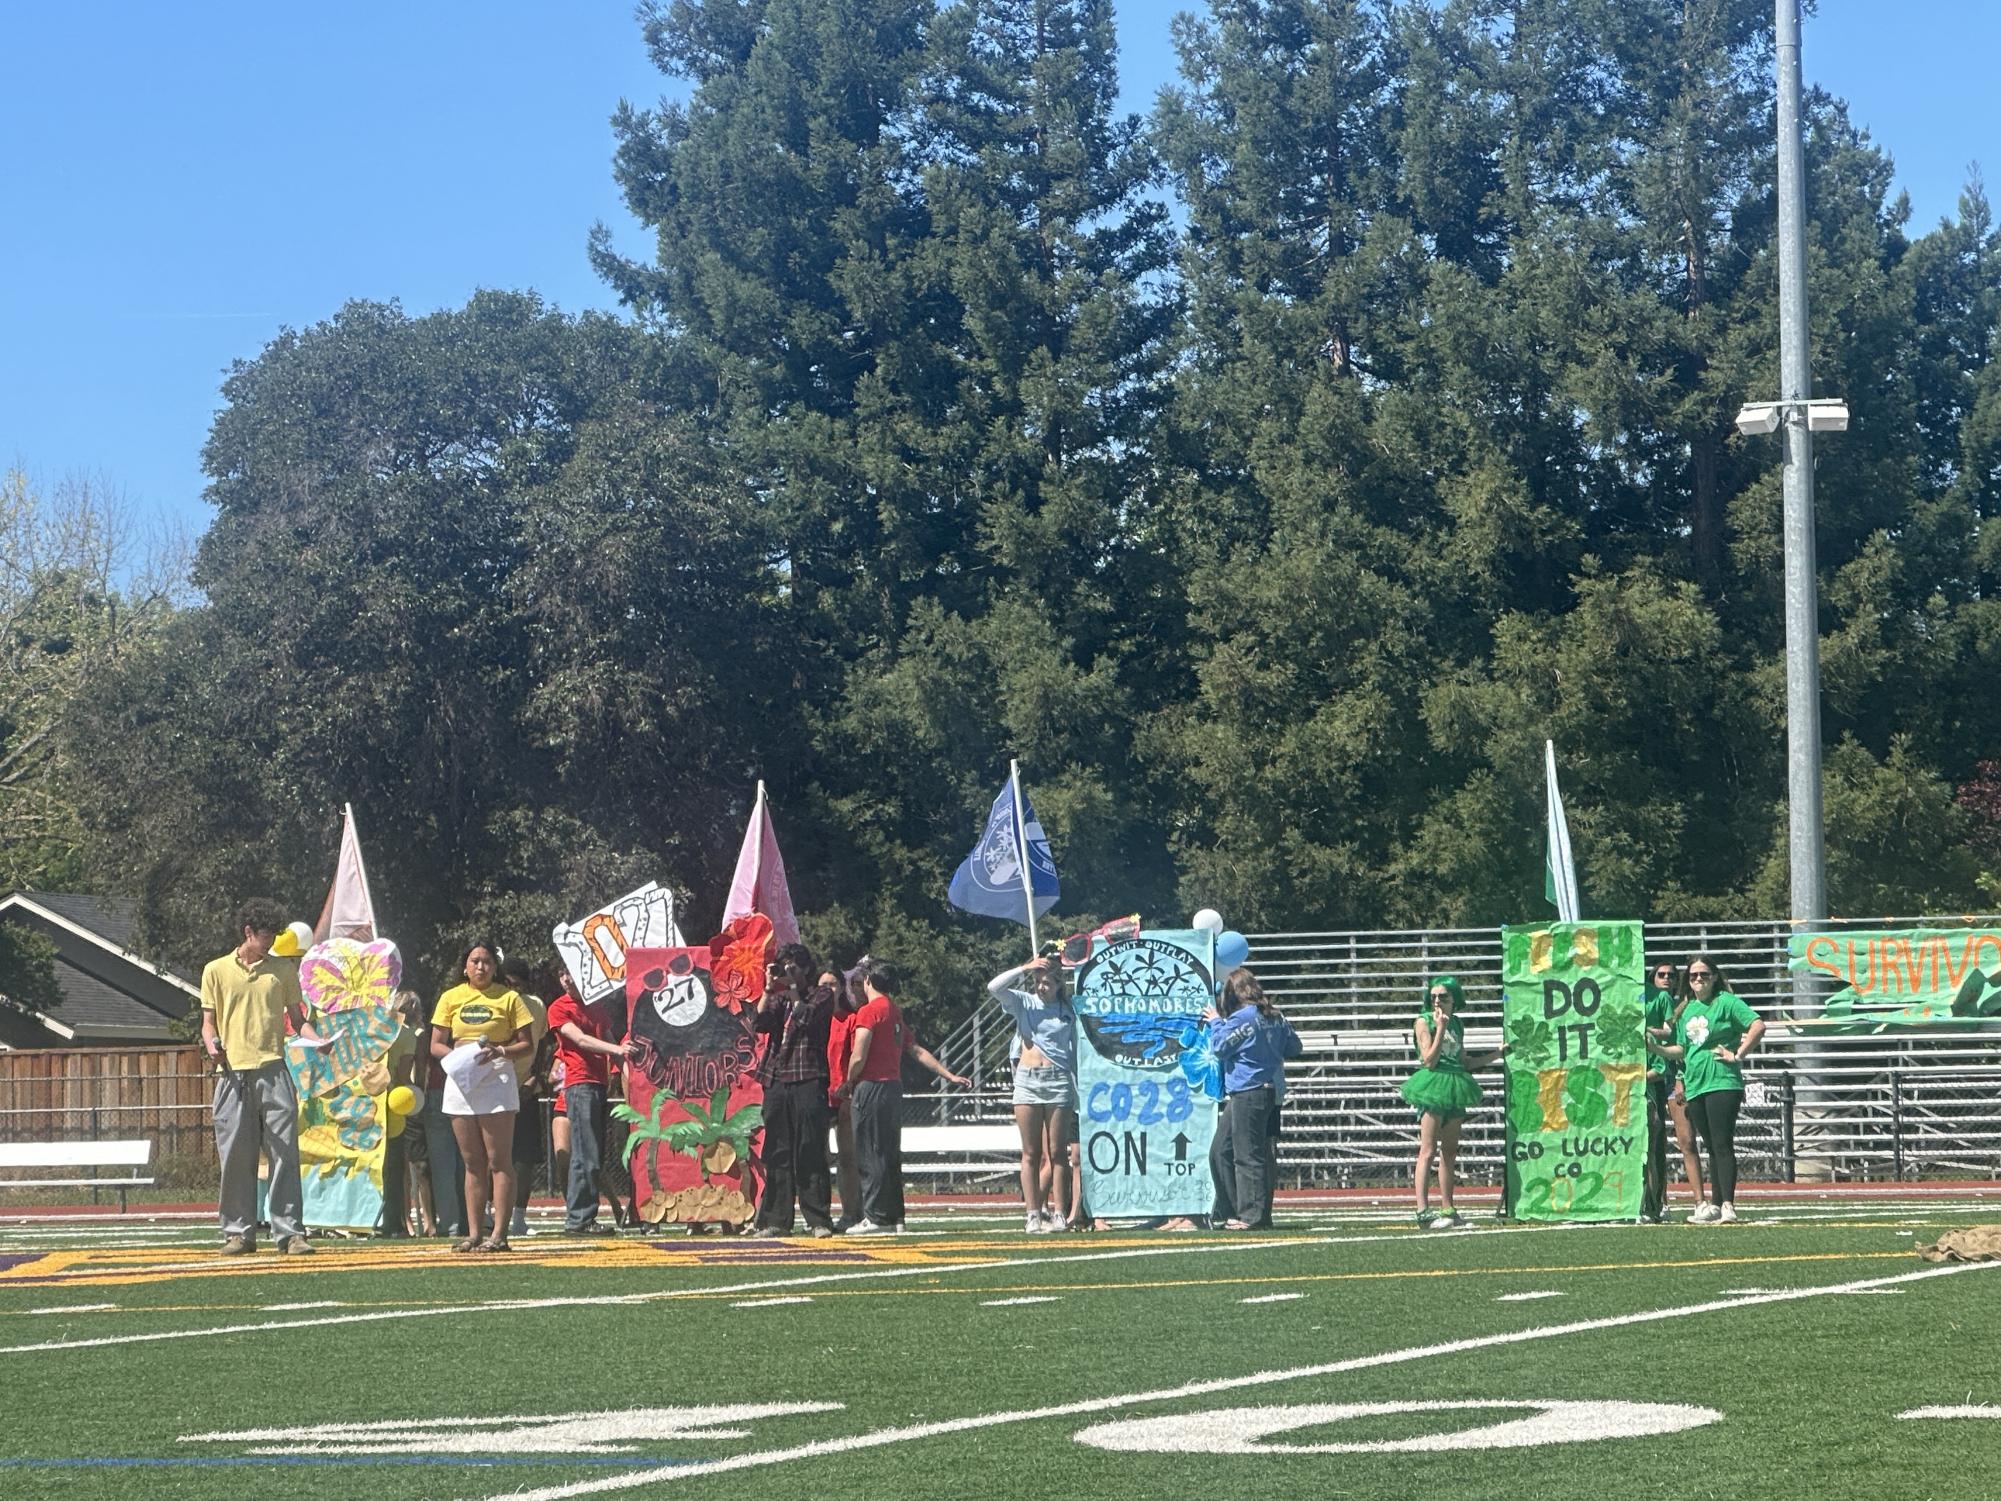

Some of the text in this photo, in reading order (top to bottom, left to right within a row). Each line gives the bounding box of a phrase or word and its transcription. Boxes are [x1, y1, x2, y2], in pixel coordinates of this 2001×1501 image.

[1096, 940, 1194, 964] OUTWIT OUTPLAY
[1082, 996, 1203, 1015] SOPHOMORES
[1543, 977, 1601, 1022] DO
[1115, 1054, 1176, 1066] OUTLAST
[1559, 1024, 1595, 1061] IT
[632, 1034, 759, 1101] JUNIORS
[1510, 1063, 1642, 1133] BEST
[1088, 1131, 1196, 1176] ON TOP
[1511, 1136, 1633, 1162] GO LUCKY
[1554, 1162, 1582, 1178] CO
[1524, 1171, 1624, 1213] 2029
